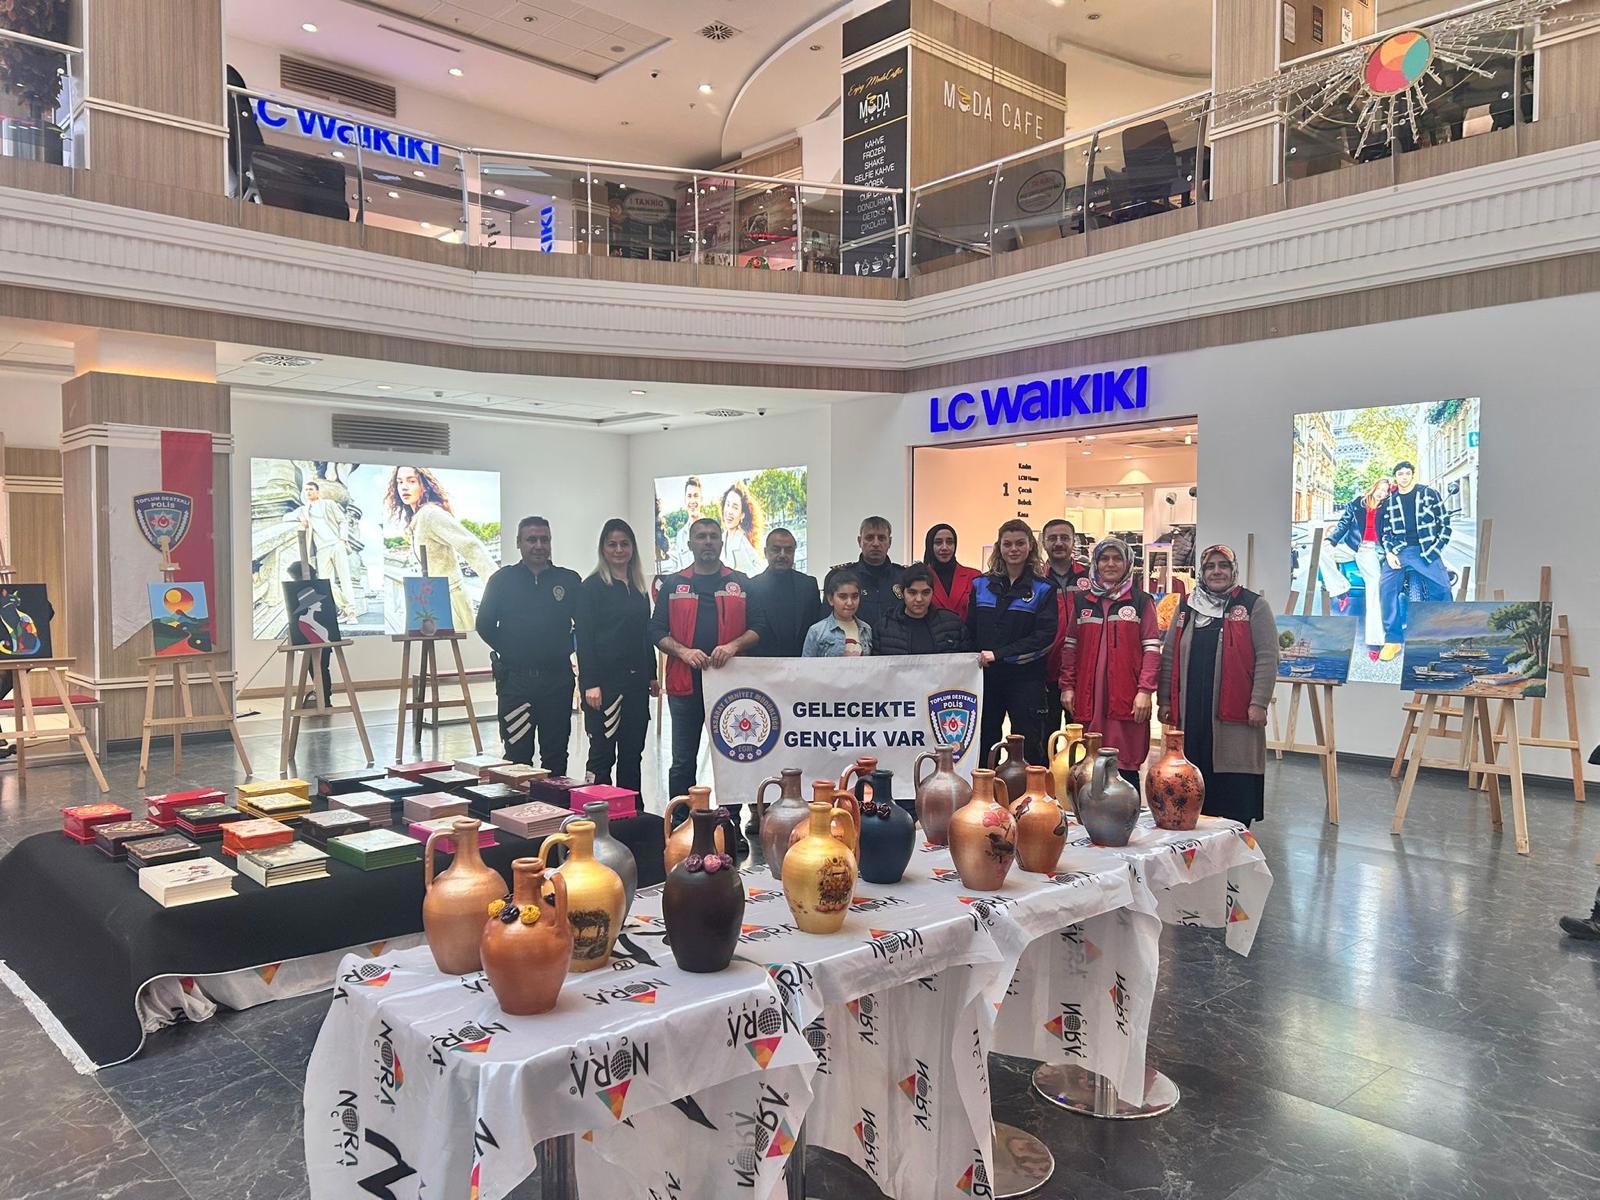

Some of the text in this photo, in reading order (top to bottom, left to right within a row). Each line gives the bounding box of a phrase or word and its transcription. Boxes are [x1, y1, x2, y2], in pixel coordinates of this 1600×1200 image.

[254, 99, 288, 127] C
[1002, 103, 1043, 140] CAFE
[862, 145, 887, 160] FROZEN
[864, 135, 885, 149] KAHVE
[864, 156, 885, 170] SHAKE
[874, 163, 895, 176] KAHVE
[930, 392, 976, 433] LC
[1003, 482, 1009, 496] 1
[793, 701, 917, 718] GELECEKTE
[930, 694, 951, 705] TOPLUM
[943, 700, 963, 708] POLİS
[784, 727, 925, 751] GENÇLİK VAR
[864, 928, 924, 959] NORA
[888, 947, 924, 964] CITY
[728, 995, 776, 1015] CITY
[728, 1002, 800, 1049] NORA
[571, 1036, 629, 1061] CITY
[379, 1019, 396, 1105] NORA
[570, 1041, 649, 1099] NORA
[331, 1110, 344, 1166] CITY
[337, 1090, 360, 1167] NORA
